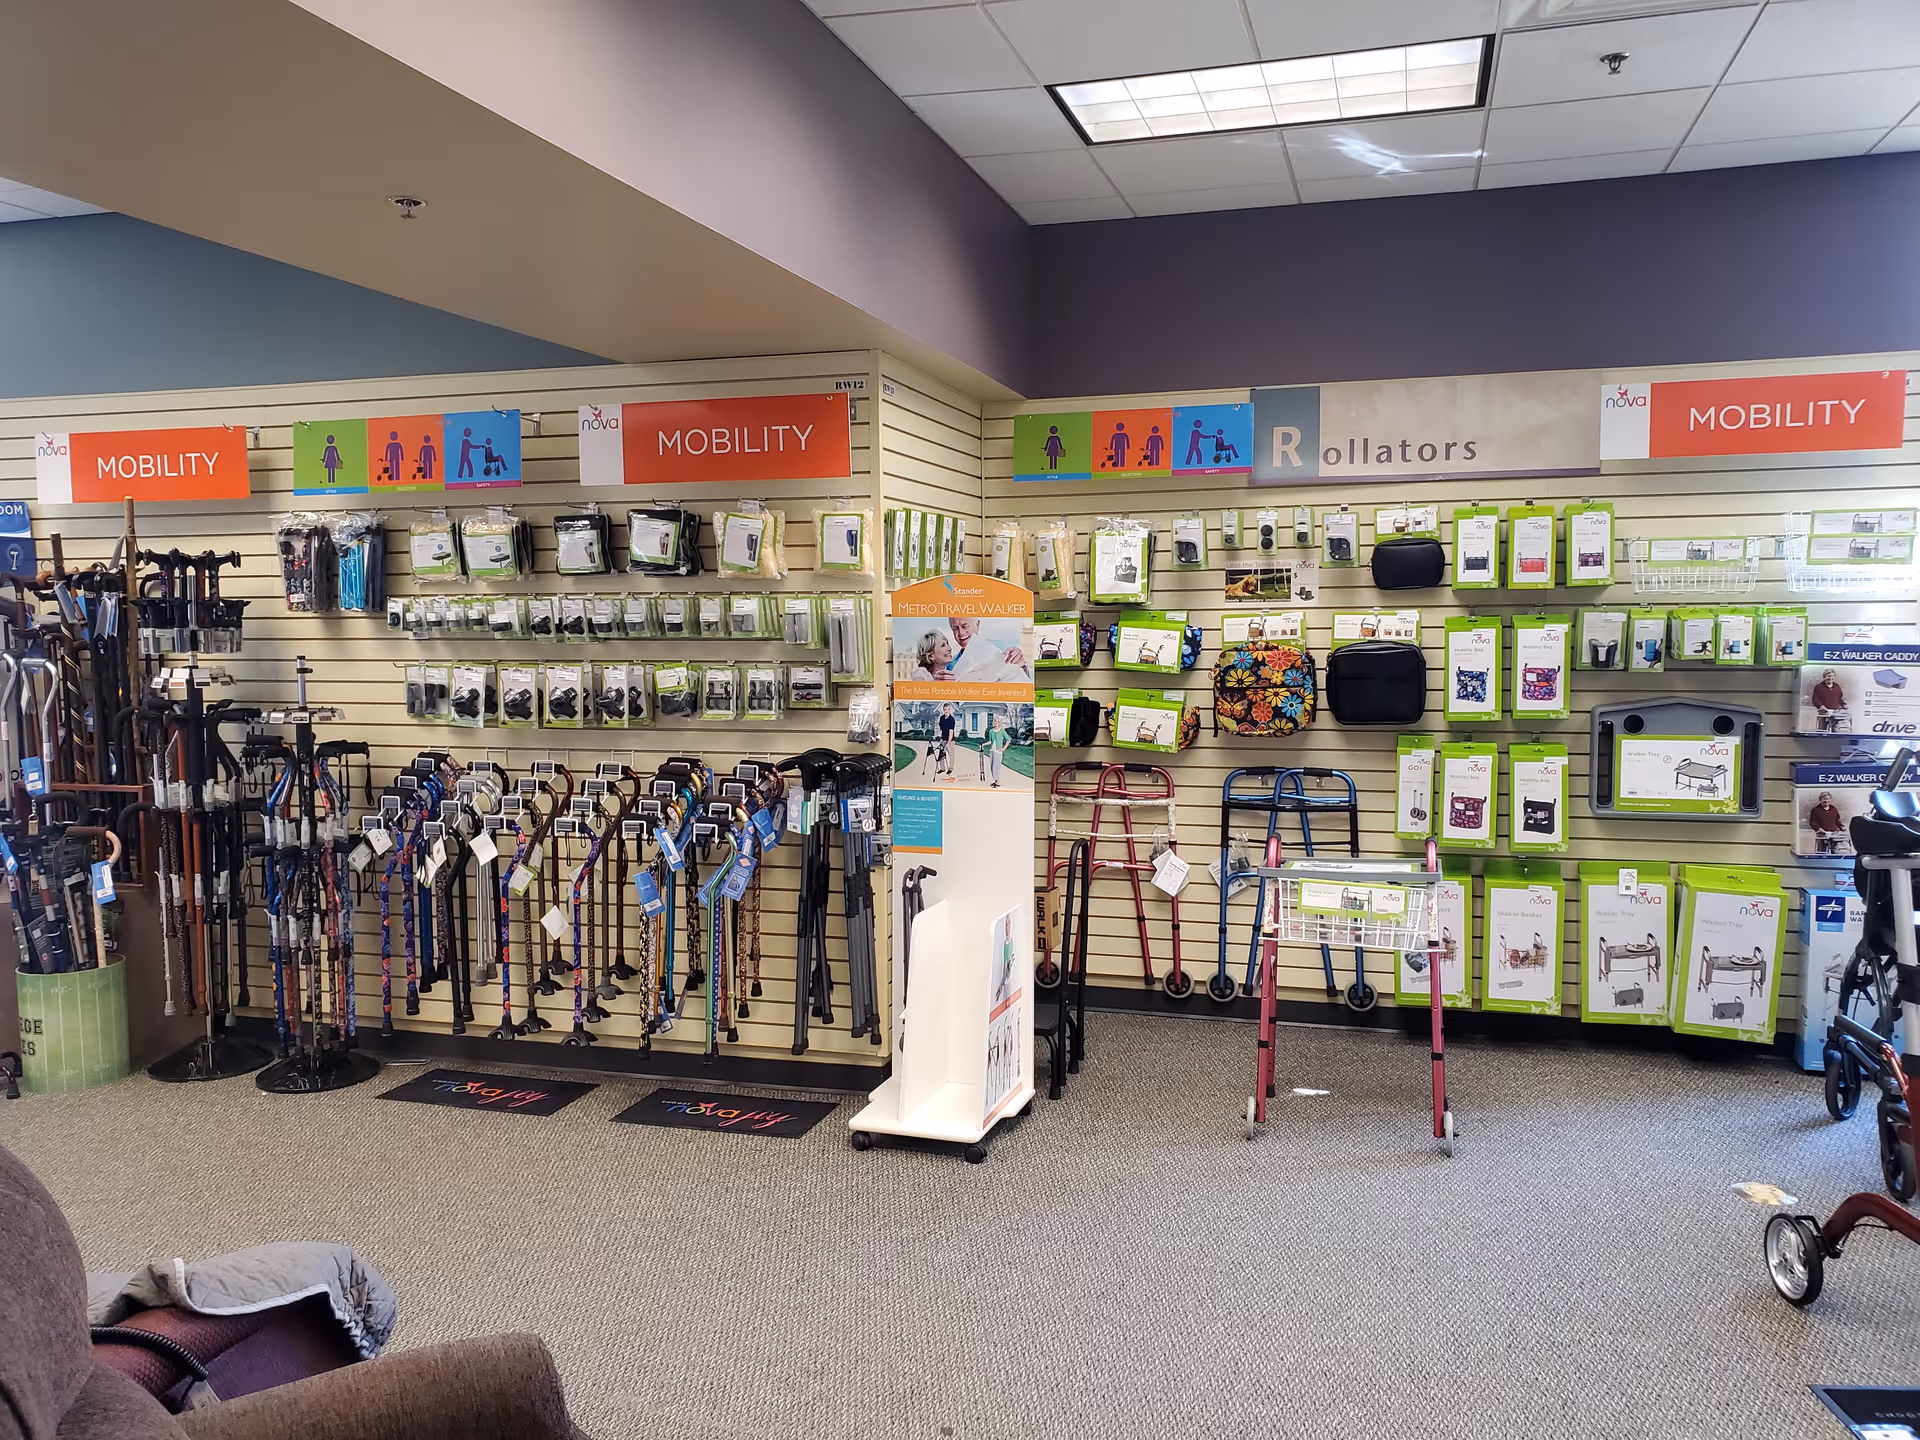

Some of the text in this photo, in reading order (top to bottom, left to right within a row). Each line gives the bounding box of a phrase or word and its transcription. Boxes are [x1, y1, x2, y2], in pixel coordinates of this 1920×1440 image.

[1605, 394, 1647, 410] nova
[1688, 399, 1867, 432] MOBILITY
[581, 414, 619, 432] nova
[658, 424, 815, 456] MOBILITY
[38, 443, 67, 457] nova
[96, 451, 220, 480] MOBILITY
[1295, 561, 1315, 569] nova
[953, 587, 983, 595] Stander
[898, 602, 1027, 615] METRO TRAVEL WALKER
[1823, 651, 1920, 661] E-Z WALKER CADDY
[958, 688, 980, 696] Walker
[982, 688, 996, 696] Ever
[1872, 720, 1917, 734] drive
[1700, 747, 1729, 756] nova
[1818, 773, 1914, 783] E-Z WALKER CDY
[1382, 894, 1400, 902] nova
[1529, 897, 1551, 905] nova
[1629, 895, 1662, 905] nova
[1496, 910, 1543, 919] Walker Basket
[1620, 910, 1635, 918] Tray
[1739, 905, 1774, 918] nova
[1701, 919, 1744, 929] Walker Tray
[666, 1104, 741, 1118] nova
